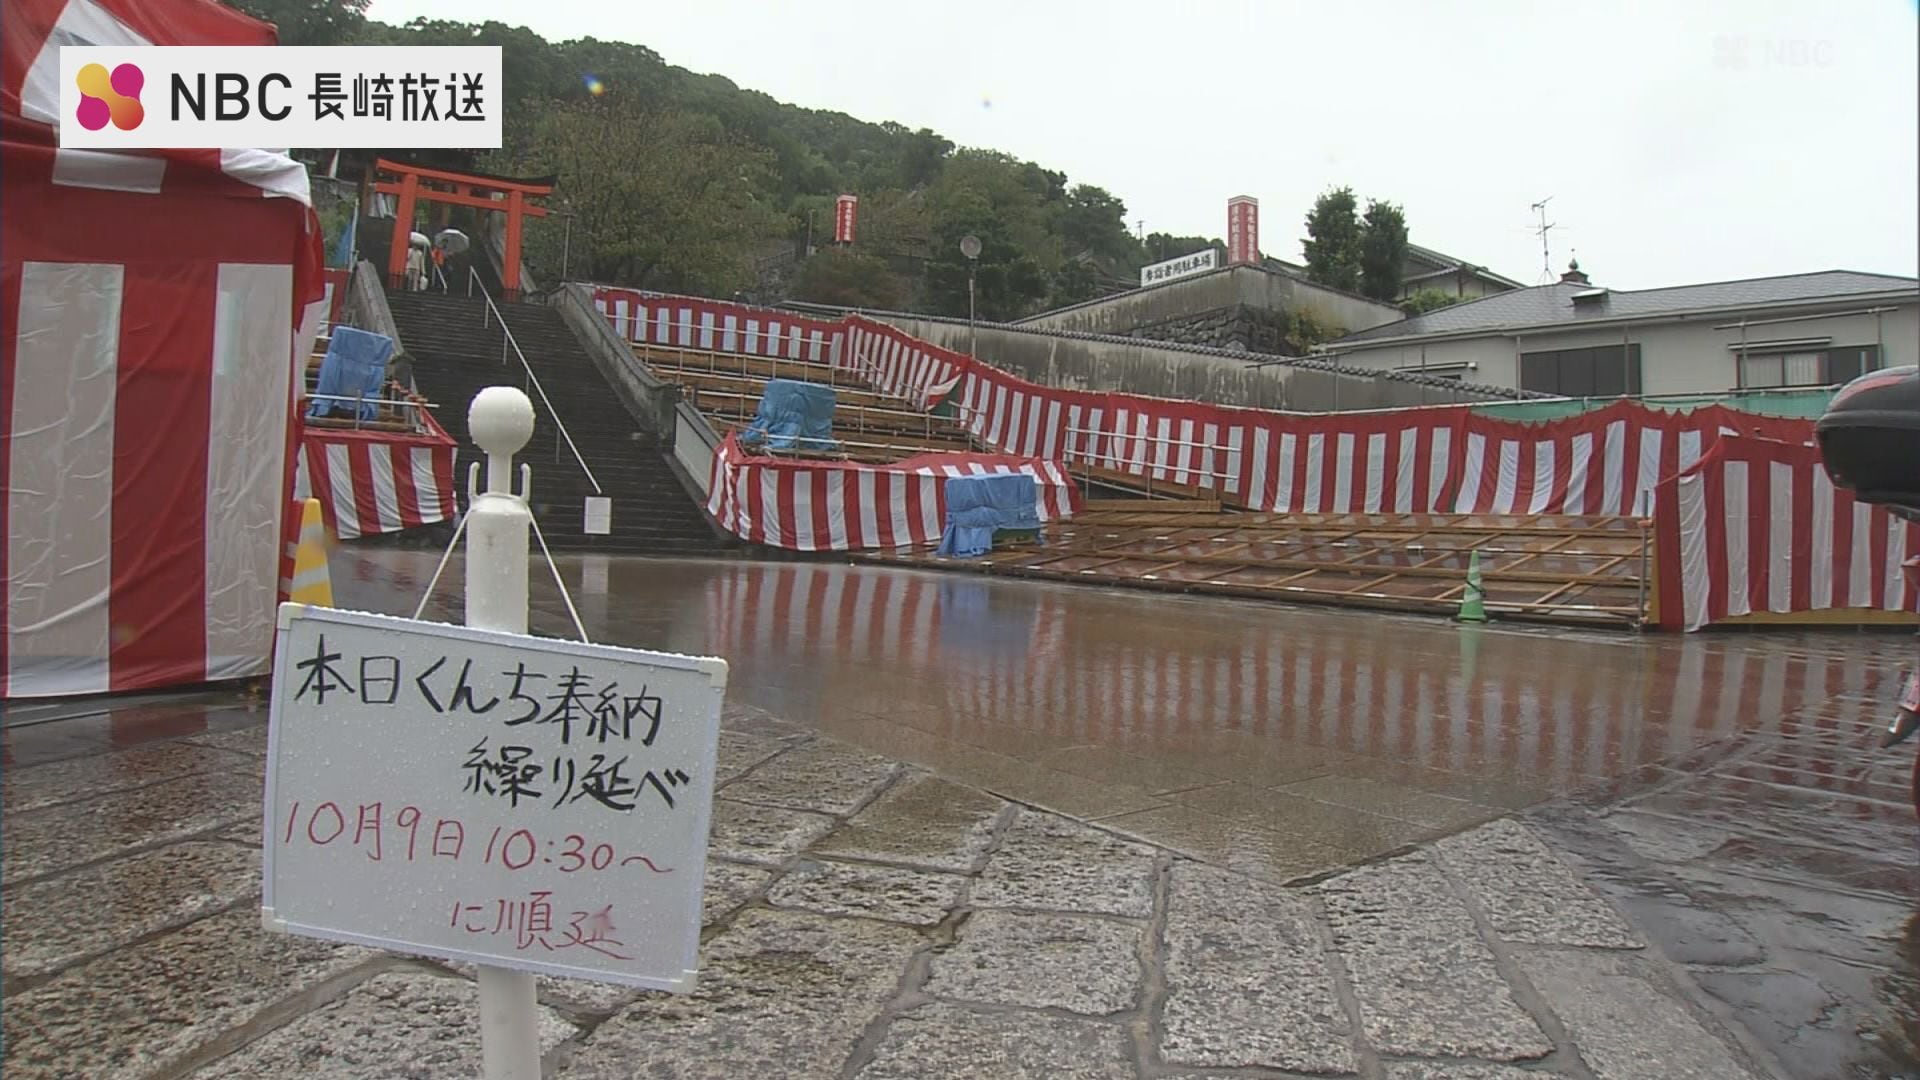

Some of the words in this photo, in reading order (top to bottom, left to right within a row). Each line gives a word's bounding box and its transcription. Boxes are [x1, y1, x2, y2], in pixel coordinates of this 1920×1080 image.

[295, 634, 663, 747] 本日くんち奉納
[461, 737, 690, 810] 繰り延べ
[285, 801, 466, 862] 10月9日
[451, 890, 636, 961] に順延
